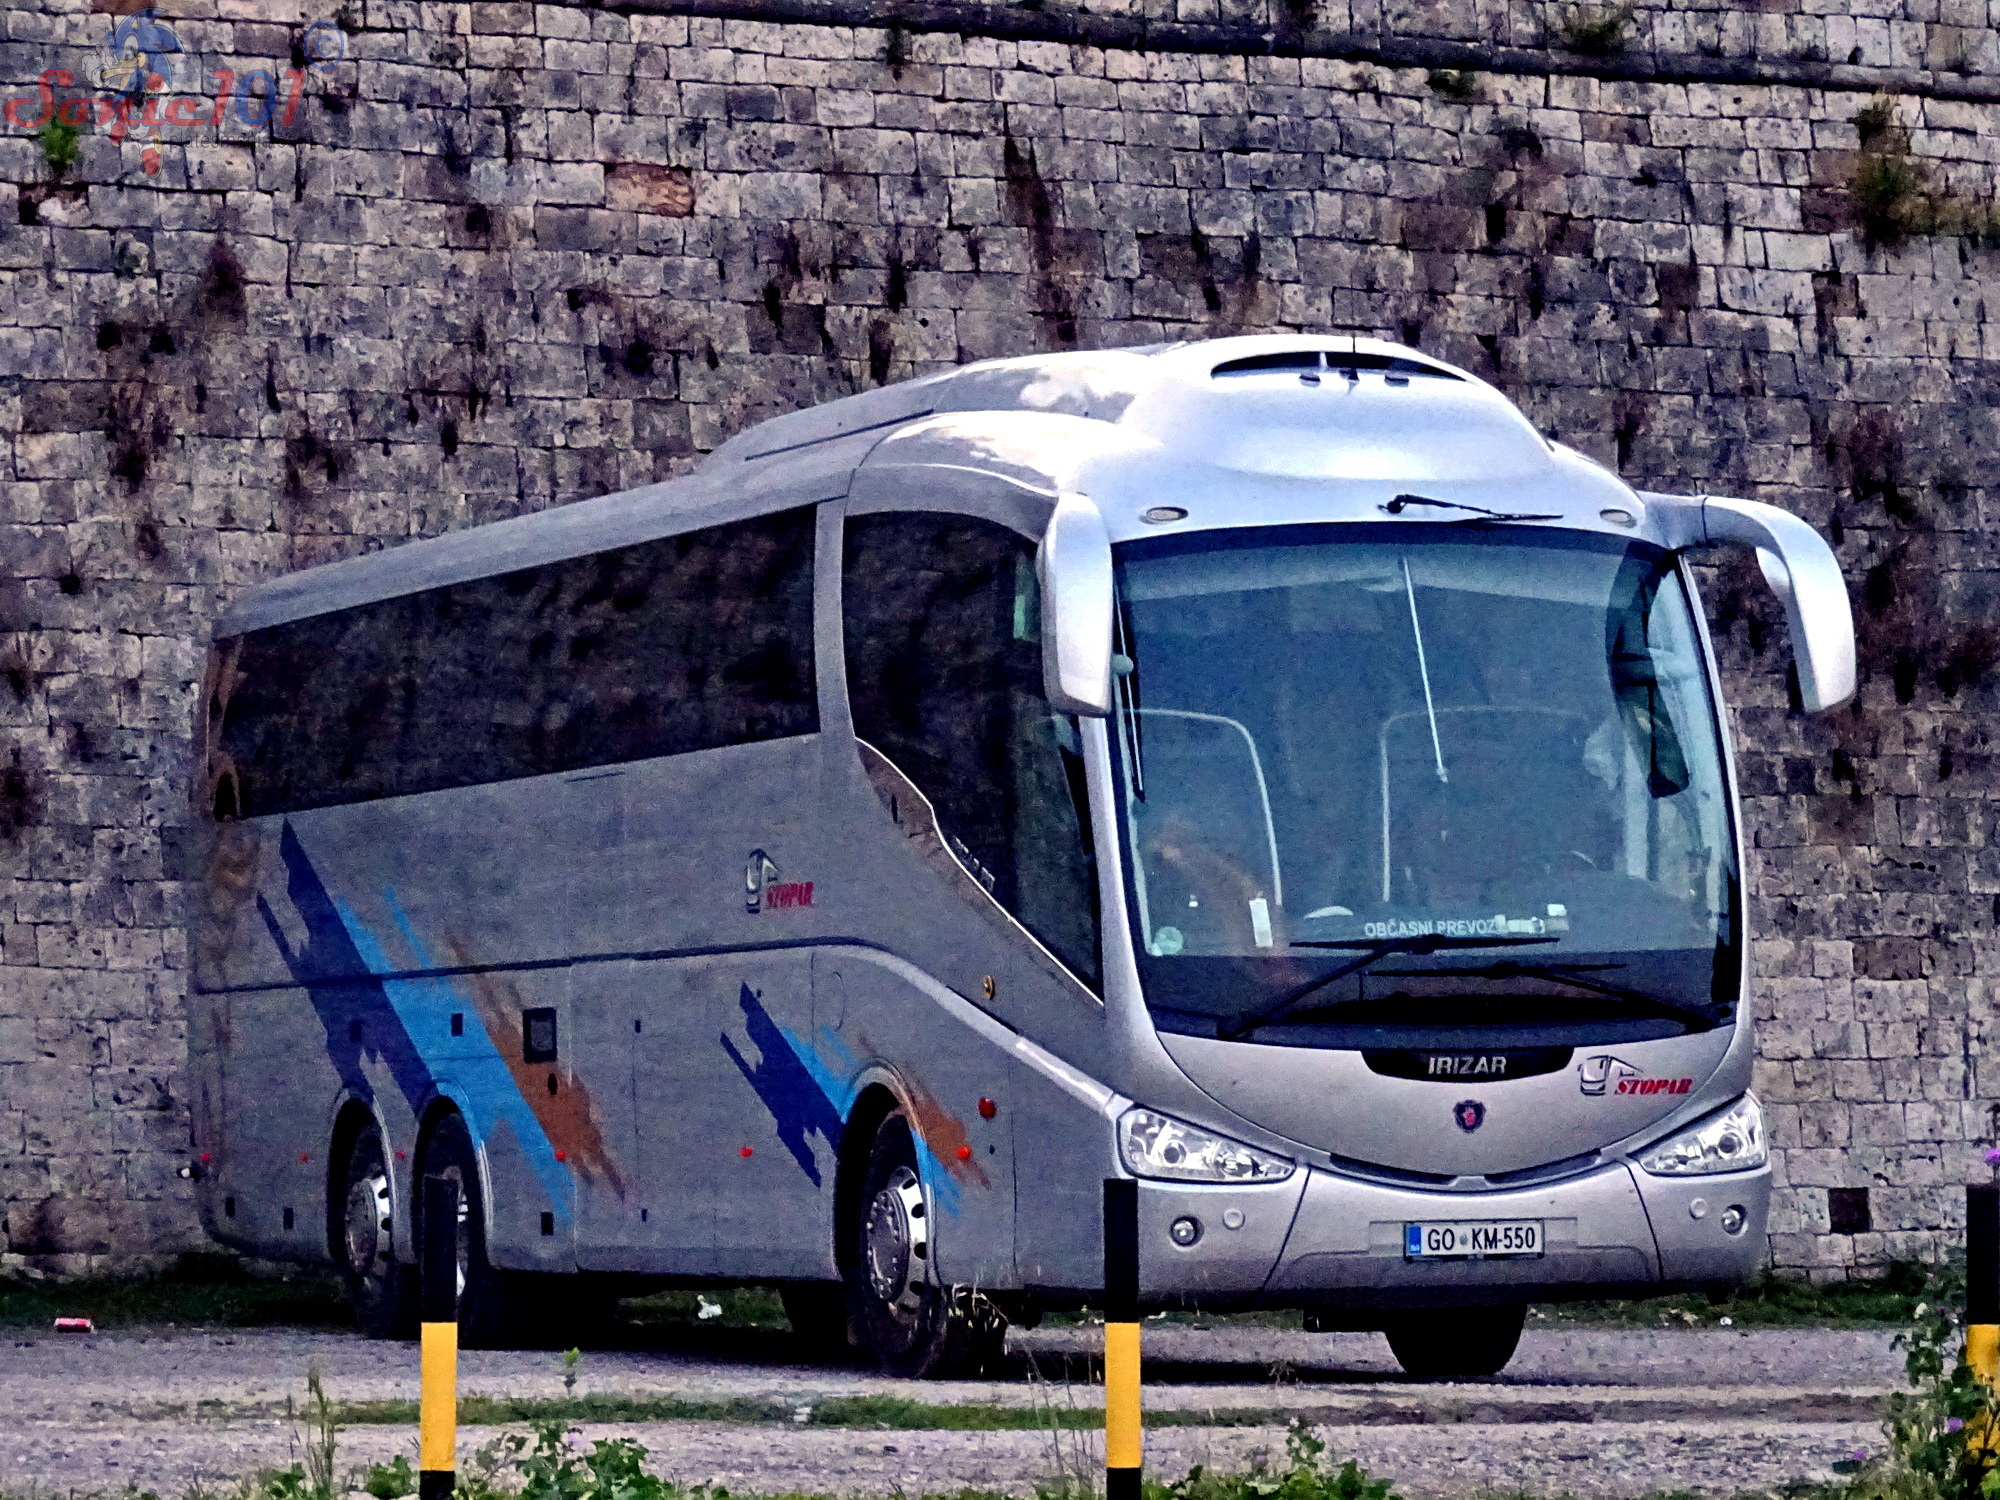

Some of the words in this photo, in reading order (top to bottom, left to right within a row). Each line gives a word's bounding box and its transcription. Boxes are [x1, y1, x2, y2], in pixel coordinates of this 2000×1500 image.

[1364, 918, 1434, 938] OBČASNI
[1428, 1056, 1507, 1075] IRIZAR
[1615, 1077, 1693, 1095] STOPAR
[1428, 1228, 1455, 1250] GO
[1472, 1227, 1536, 1249] KM-550
